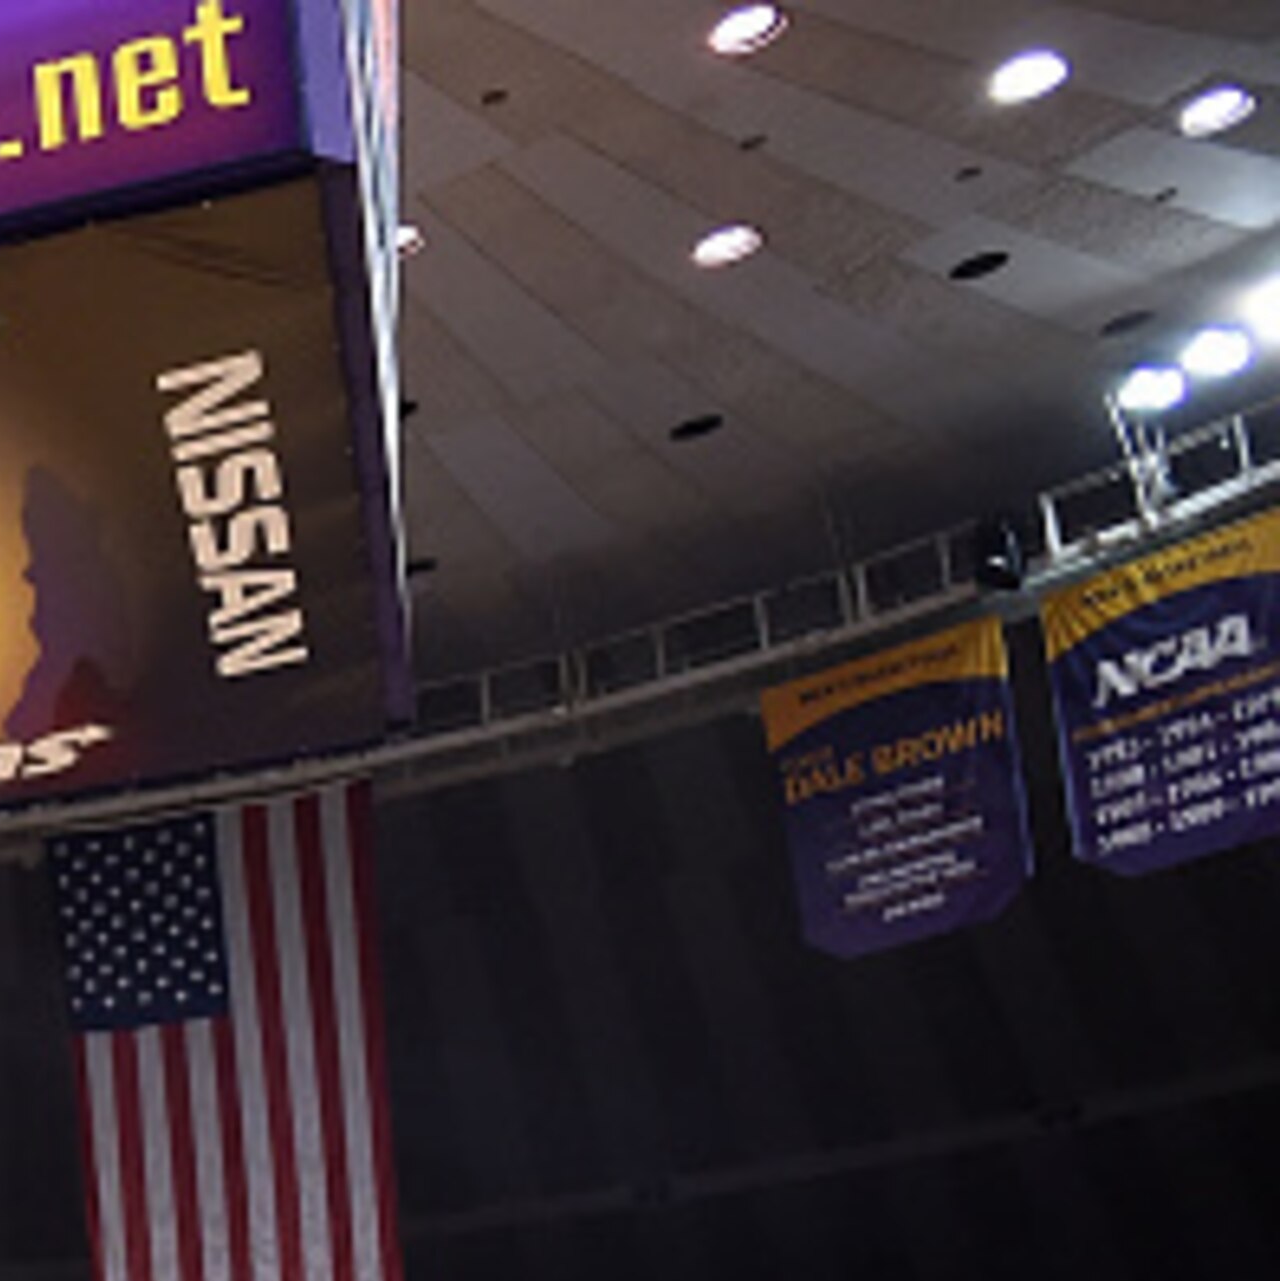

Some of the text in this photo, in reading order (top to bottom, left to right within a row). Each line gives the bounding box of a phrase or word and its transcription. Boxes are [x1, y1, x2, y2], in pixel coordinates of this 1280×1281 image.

[155, 348, 309, 682] NISSAN
[1091, 613, 1253, 709] NCAA
[872, 710, 1004, 774] BROWN
